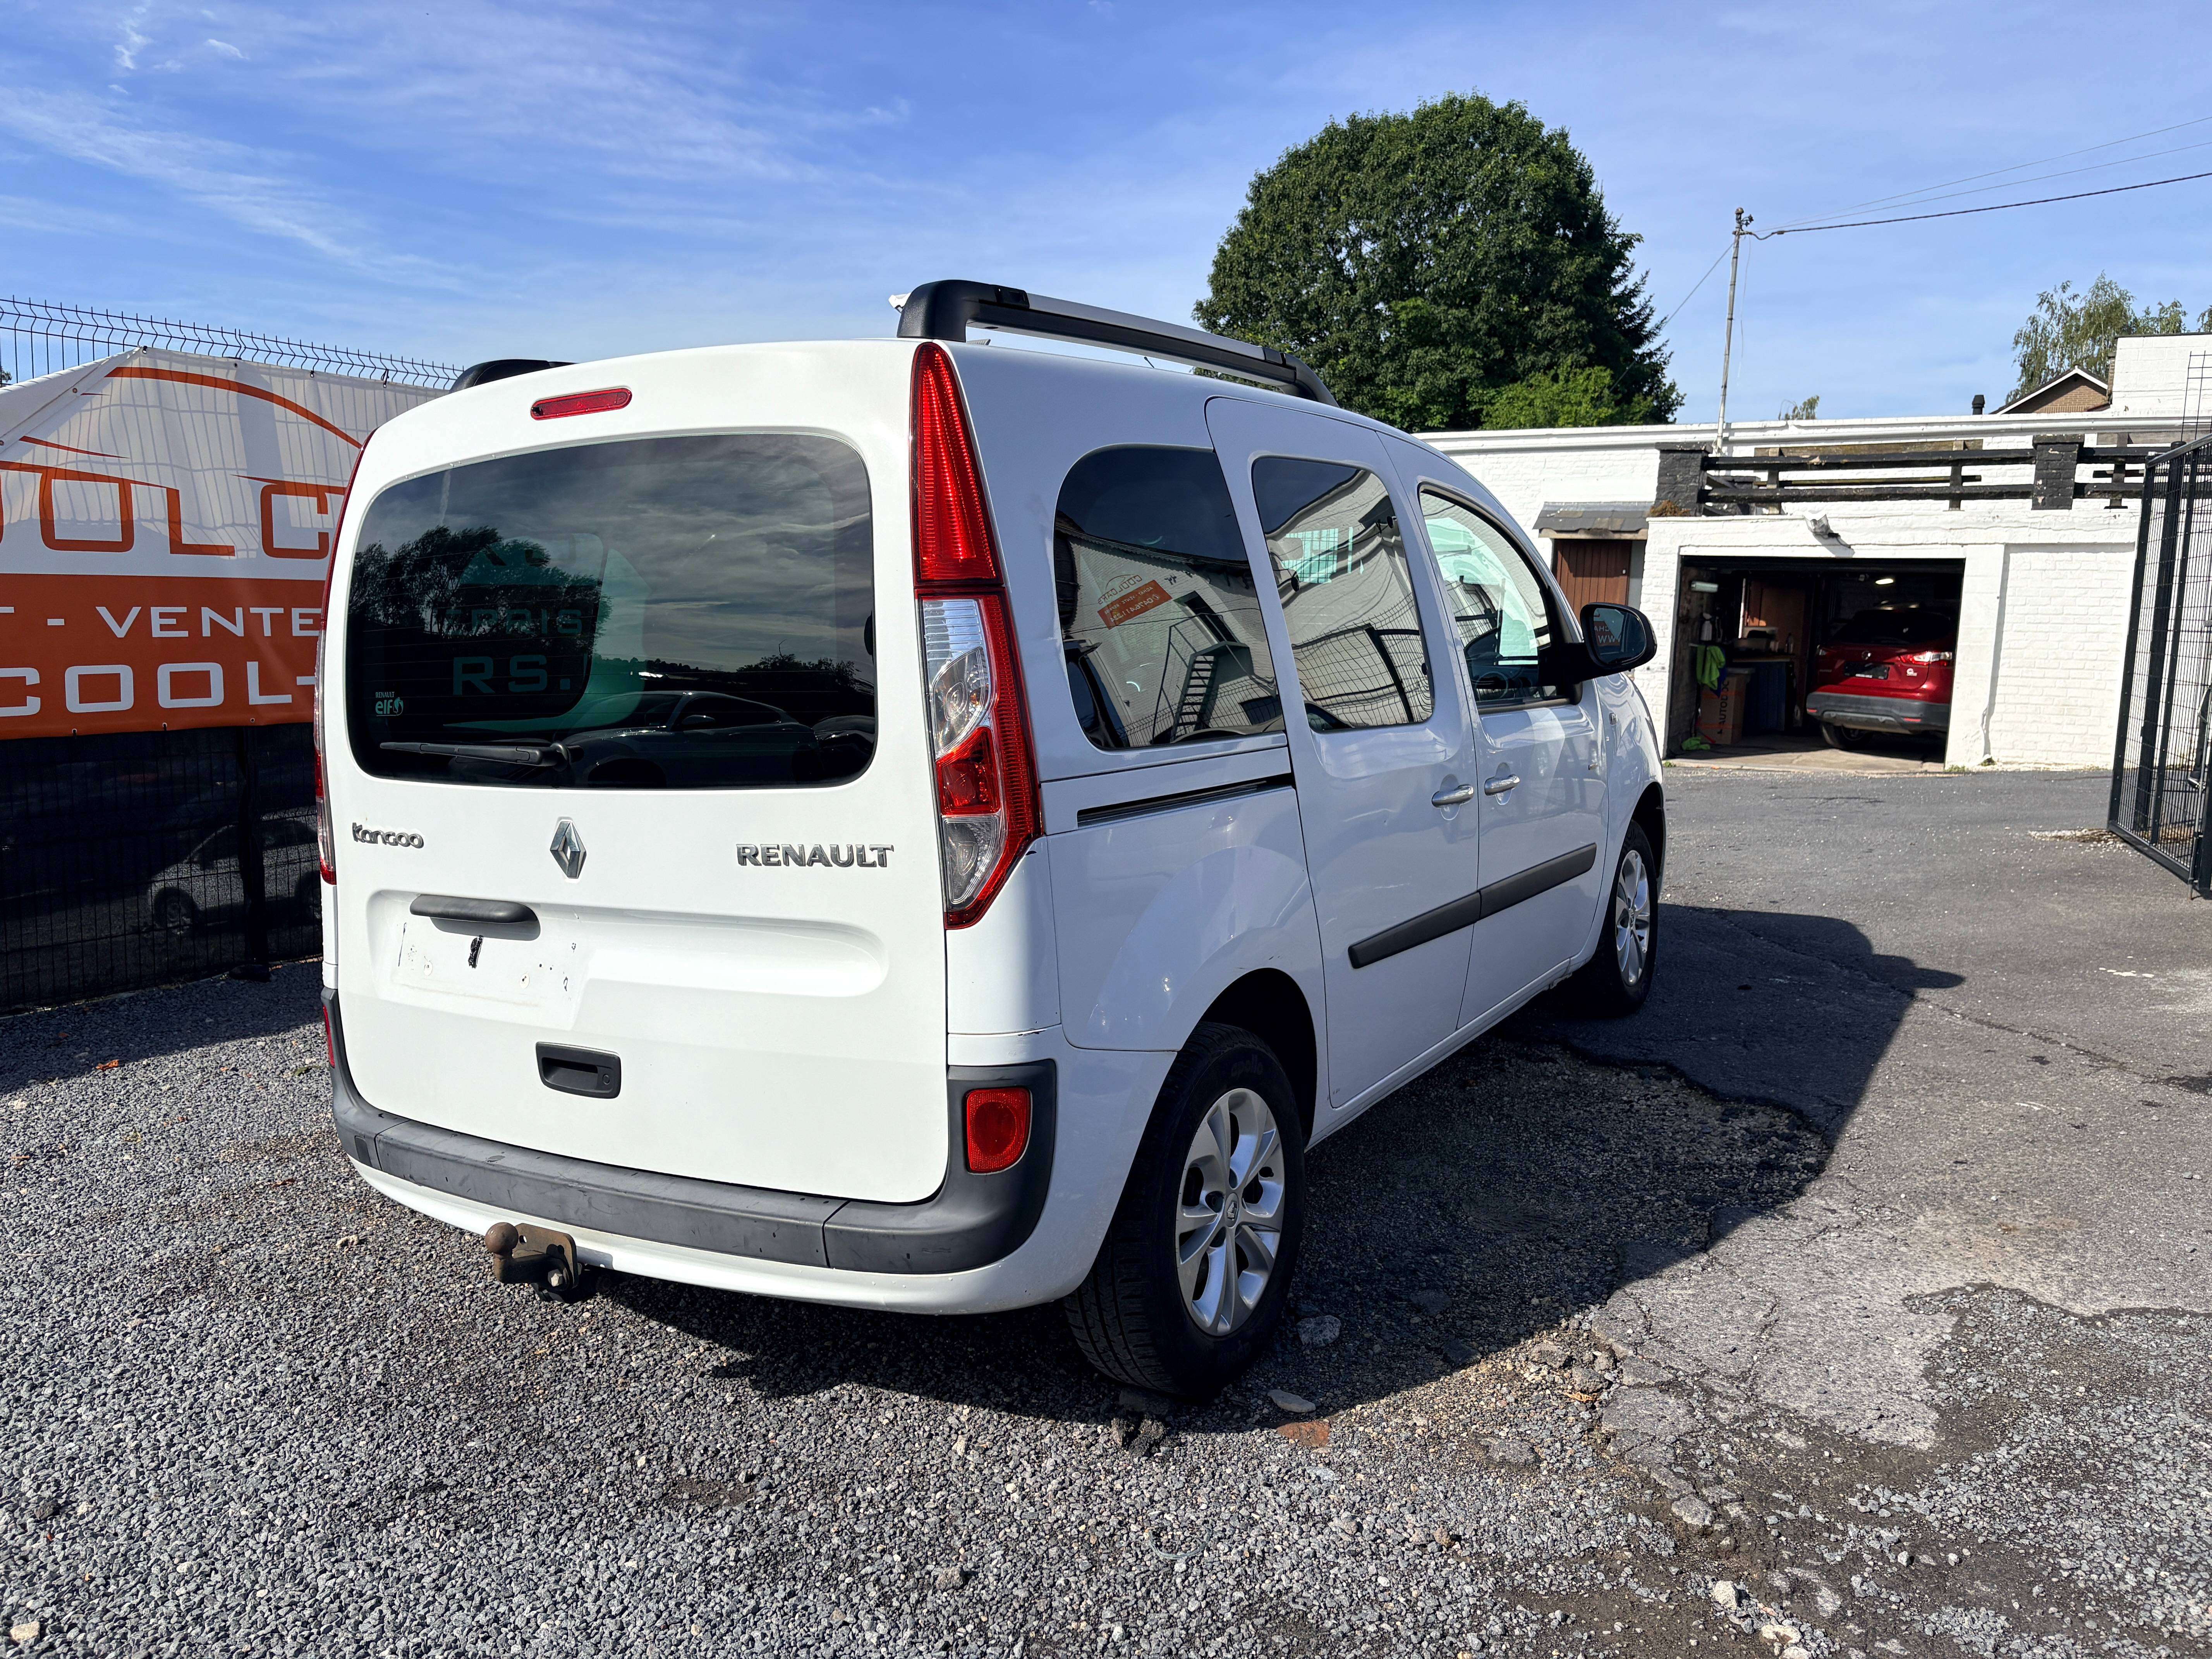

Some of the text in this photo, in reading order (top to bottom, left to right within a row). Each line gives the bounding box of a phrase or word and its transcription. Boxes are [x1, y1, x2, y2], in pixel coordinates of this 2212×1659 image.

[96, 606, 322, 638] VENTE
[375, 699, 393, 714] elf
[736, 843, 894, 867] RENAULT
